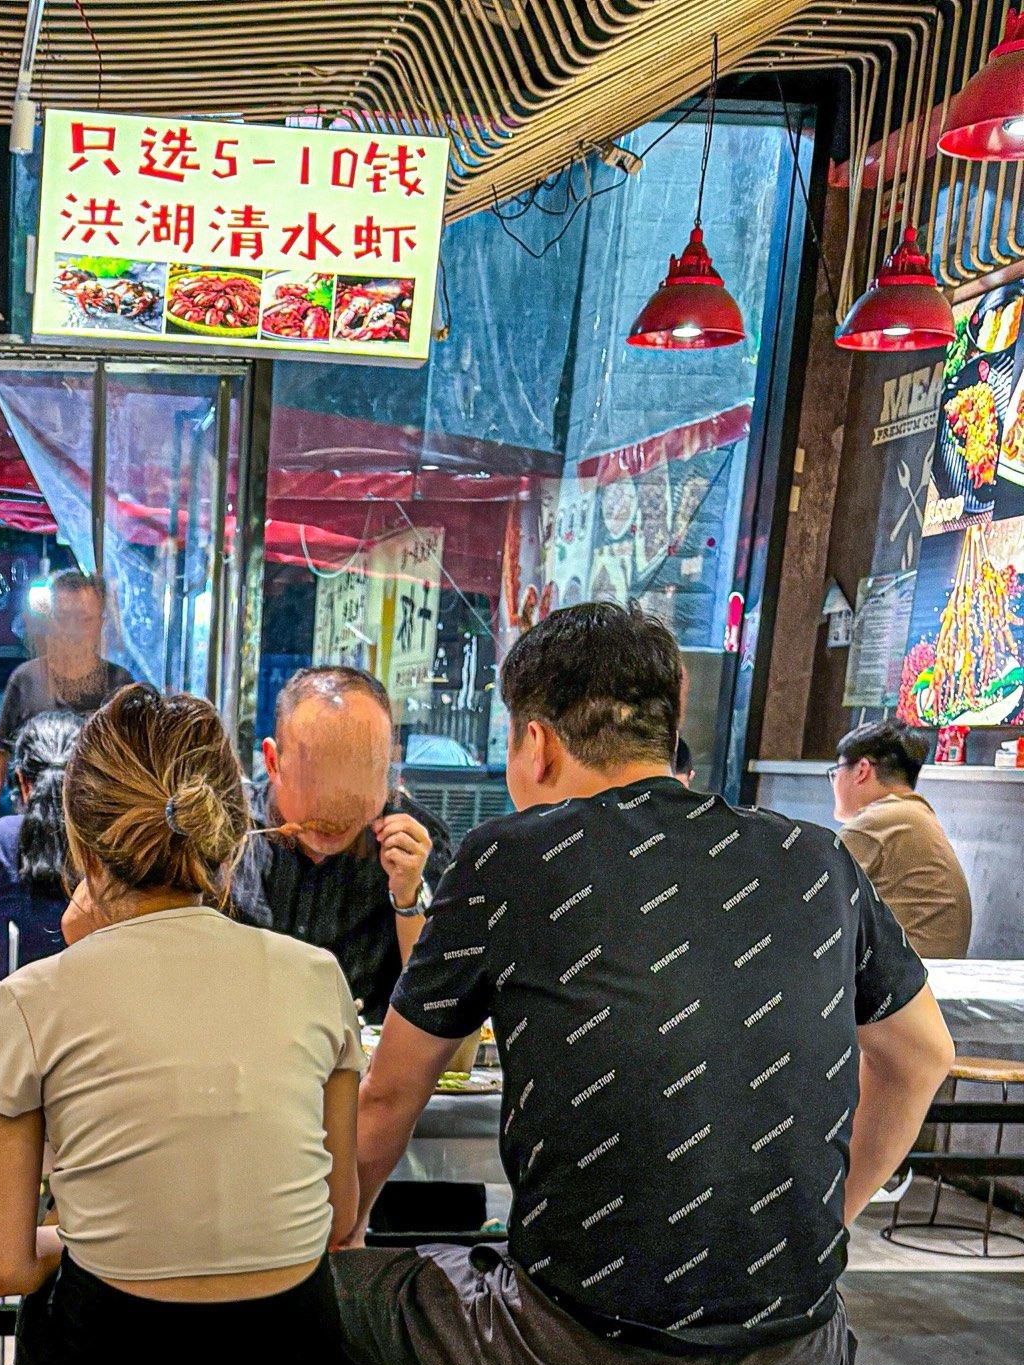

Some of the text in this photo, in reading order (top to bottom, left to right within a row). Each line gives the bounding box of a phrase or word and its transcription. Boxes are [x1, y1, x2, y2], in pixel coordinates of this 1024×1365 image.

[60, 193, 417, 263] 洪湖清水虾
